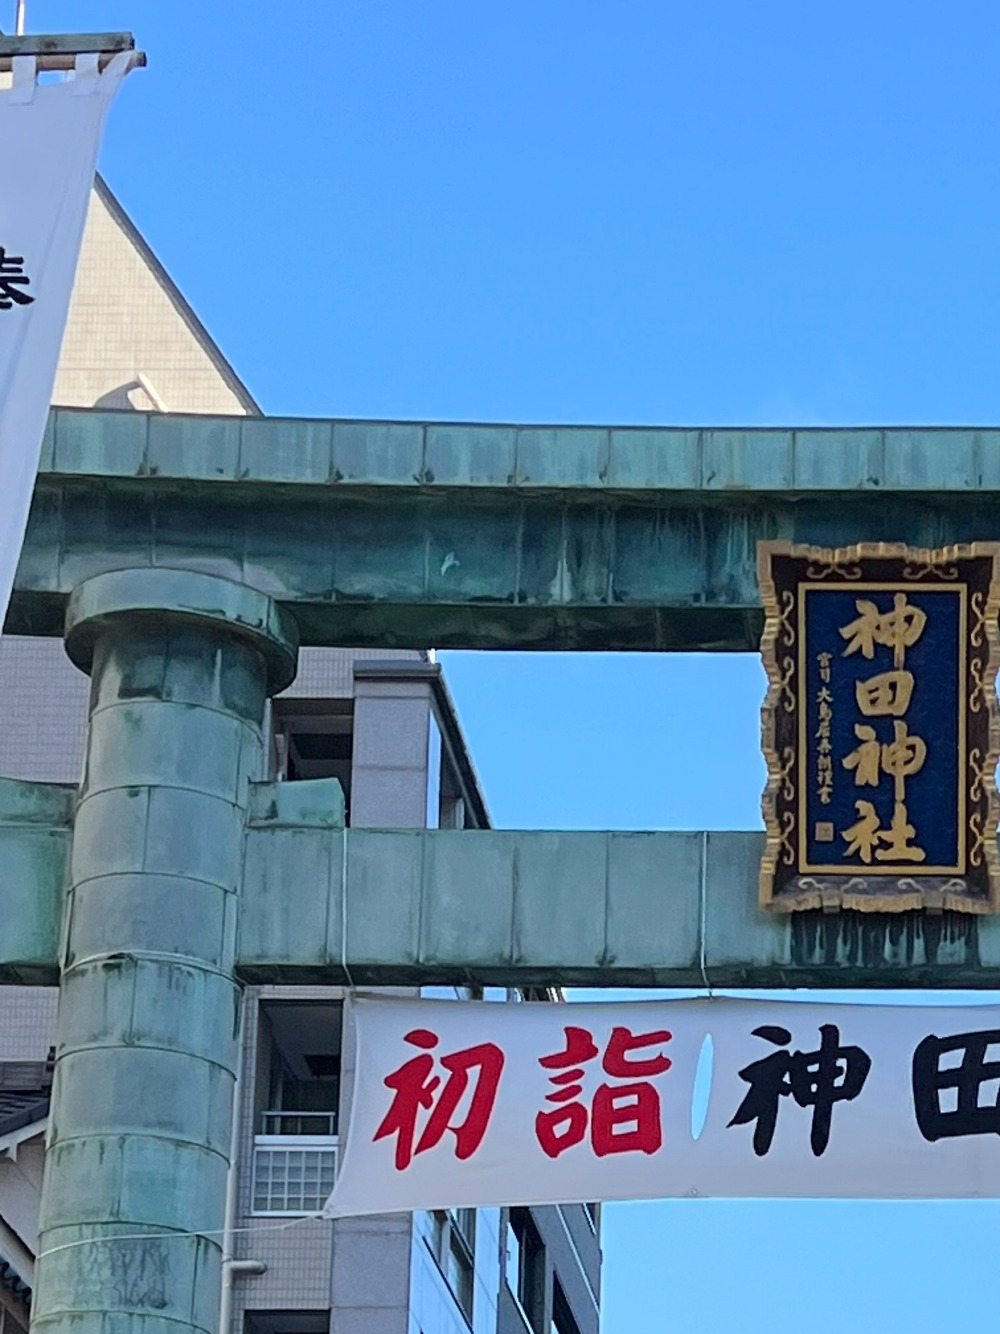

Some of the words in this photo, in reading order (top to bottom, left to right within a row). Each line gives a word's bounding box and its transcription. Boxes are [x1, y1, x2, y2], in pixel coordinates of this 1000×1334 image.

[838, 592, 927, 863] 神田神社
[372, 1025, 676, 1173] 初詣
